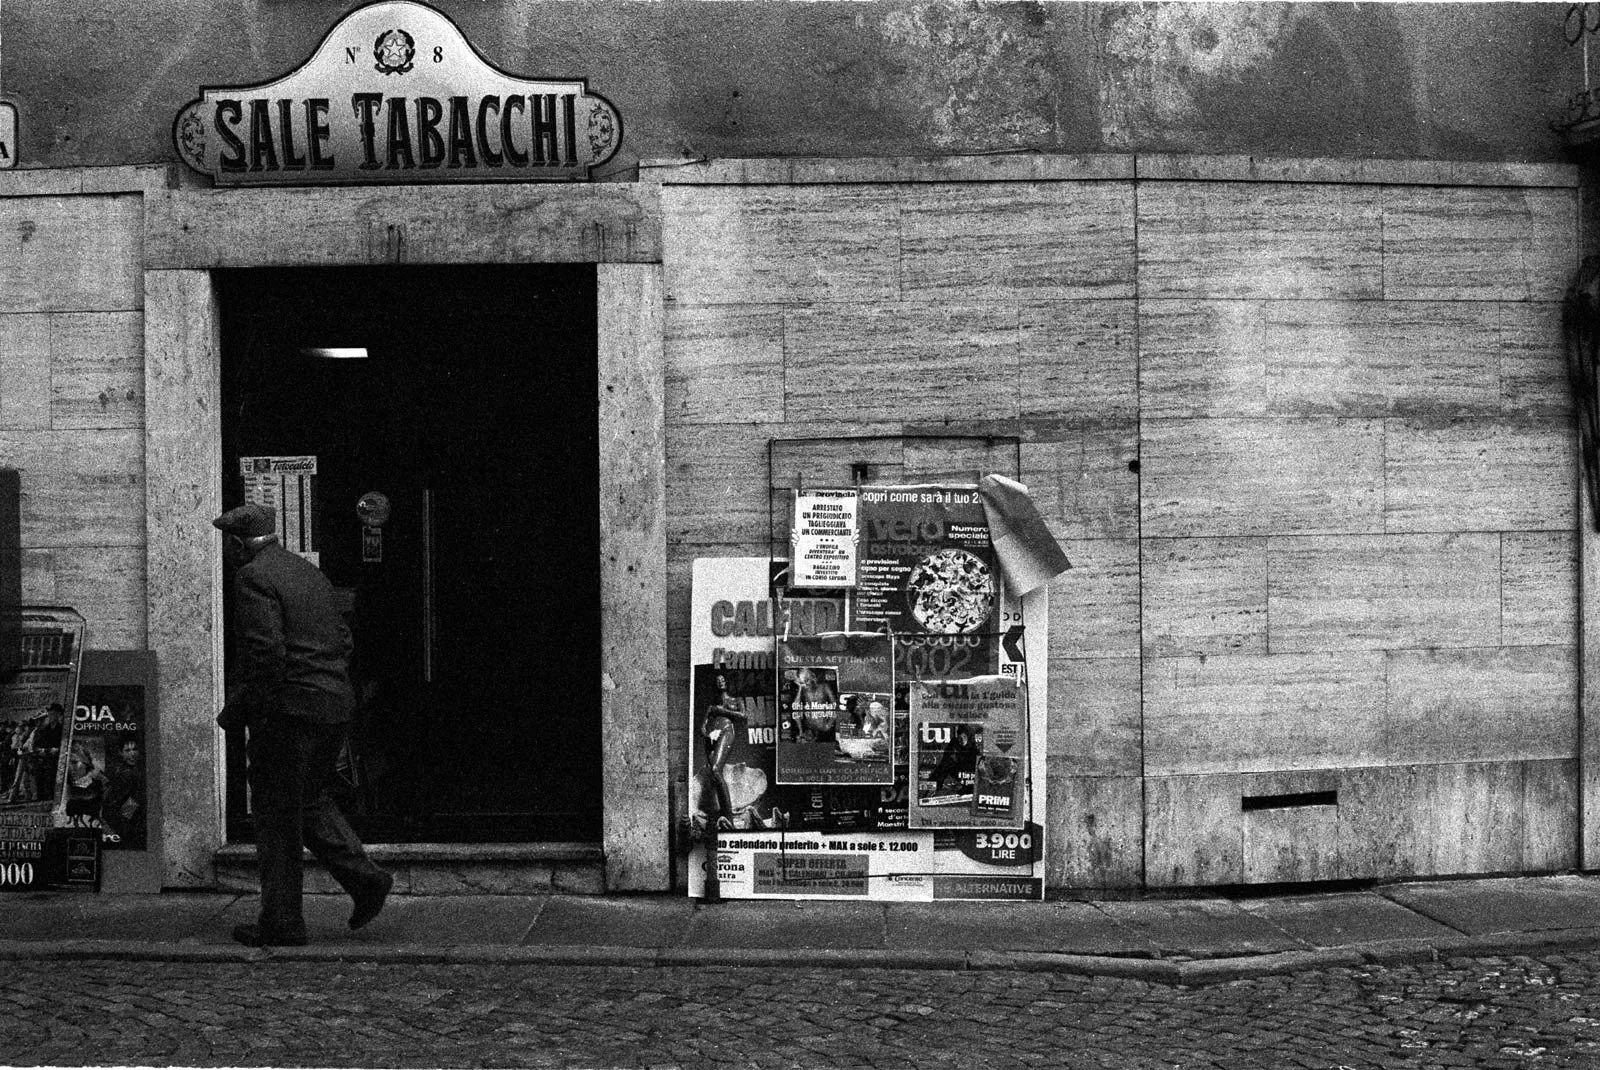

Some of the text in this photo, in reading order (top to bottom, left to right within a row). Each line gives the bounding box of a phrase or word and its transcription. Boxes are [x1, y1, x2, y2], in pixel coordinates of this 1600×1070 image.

[432, 46, 444, 64] 8
[214, 92, 578, 173] SALE TABACCHI
[815, 490, 856, 499] provincia
[890, 493, 918, 503] come
[920, 491, 944, 504] sarà
[945, 491, 952, 503] il
[954, 492, 971, 504] tuo
[812, 504, 843, 512] ARRESTATO
[802, 512, 853, 520] UN PREGIUDICATO
[808, 520, 847, 528] TAGLIEGGIAVA
[951, 525, 989, 533] Numero
[801, 528, 853, 537] UN COMMERCIANTE
[949, 532, 989, 542] speciale
[784, 655, 823, 664] QUESTA
[115, 722, 137, 731] BAG
[747, 727, 777, 745] MO
[919, 722, 951, 744] tu
[978, 794, 1011, 806] PRIMI
[729, 838, 778, 850] calendario
[779, 839, 820, 851] preferito
[829, 841, 849, 851] MAX
[850, 843, 857, 851] a
[858, 840, 877, 852] sole
[890, 842, 919, 853] 12.000
[975, 833, 1033, 849] 3.900
[991, 849, 1017, 860] LIRE
[777, 858, 847, 869] SUPER OFFERTA
[718, 872, 736, 880] xtra
[954, 883, 1034, 895] ALTERNATIVE
